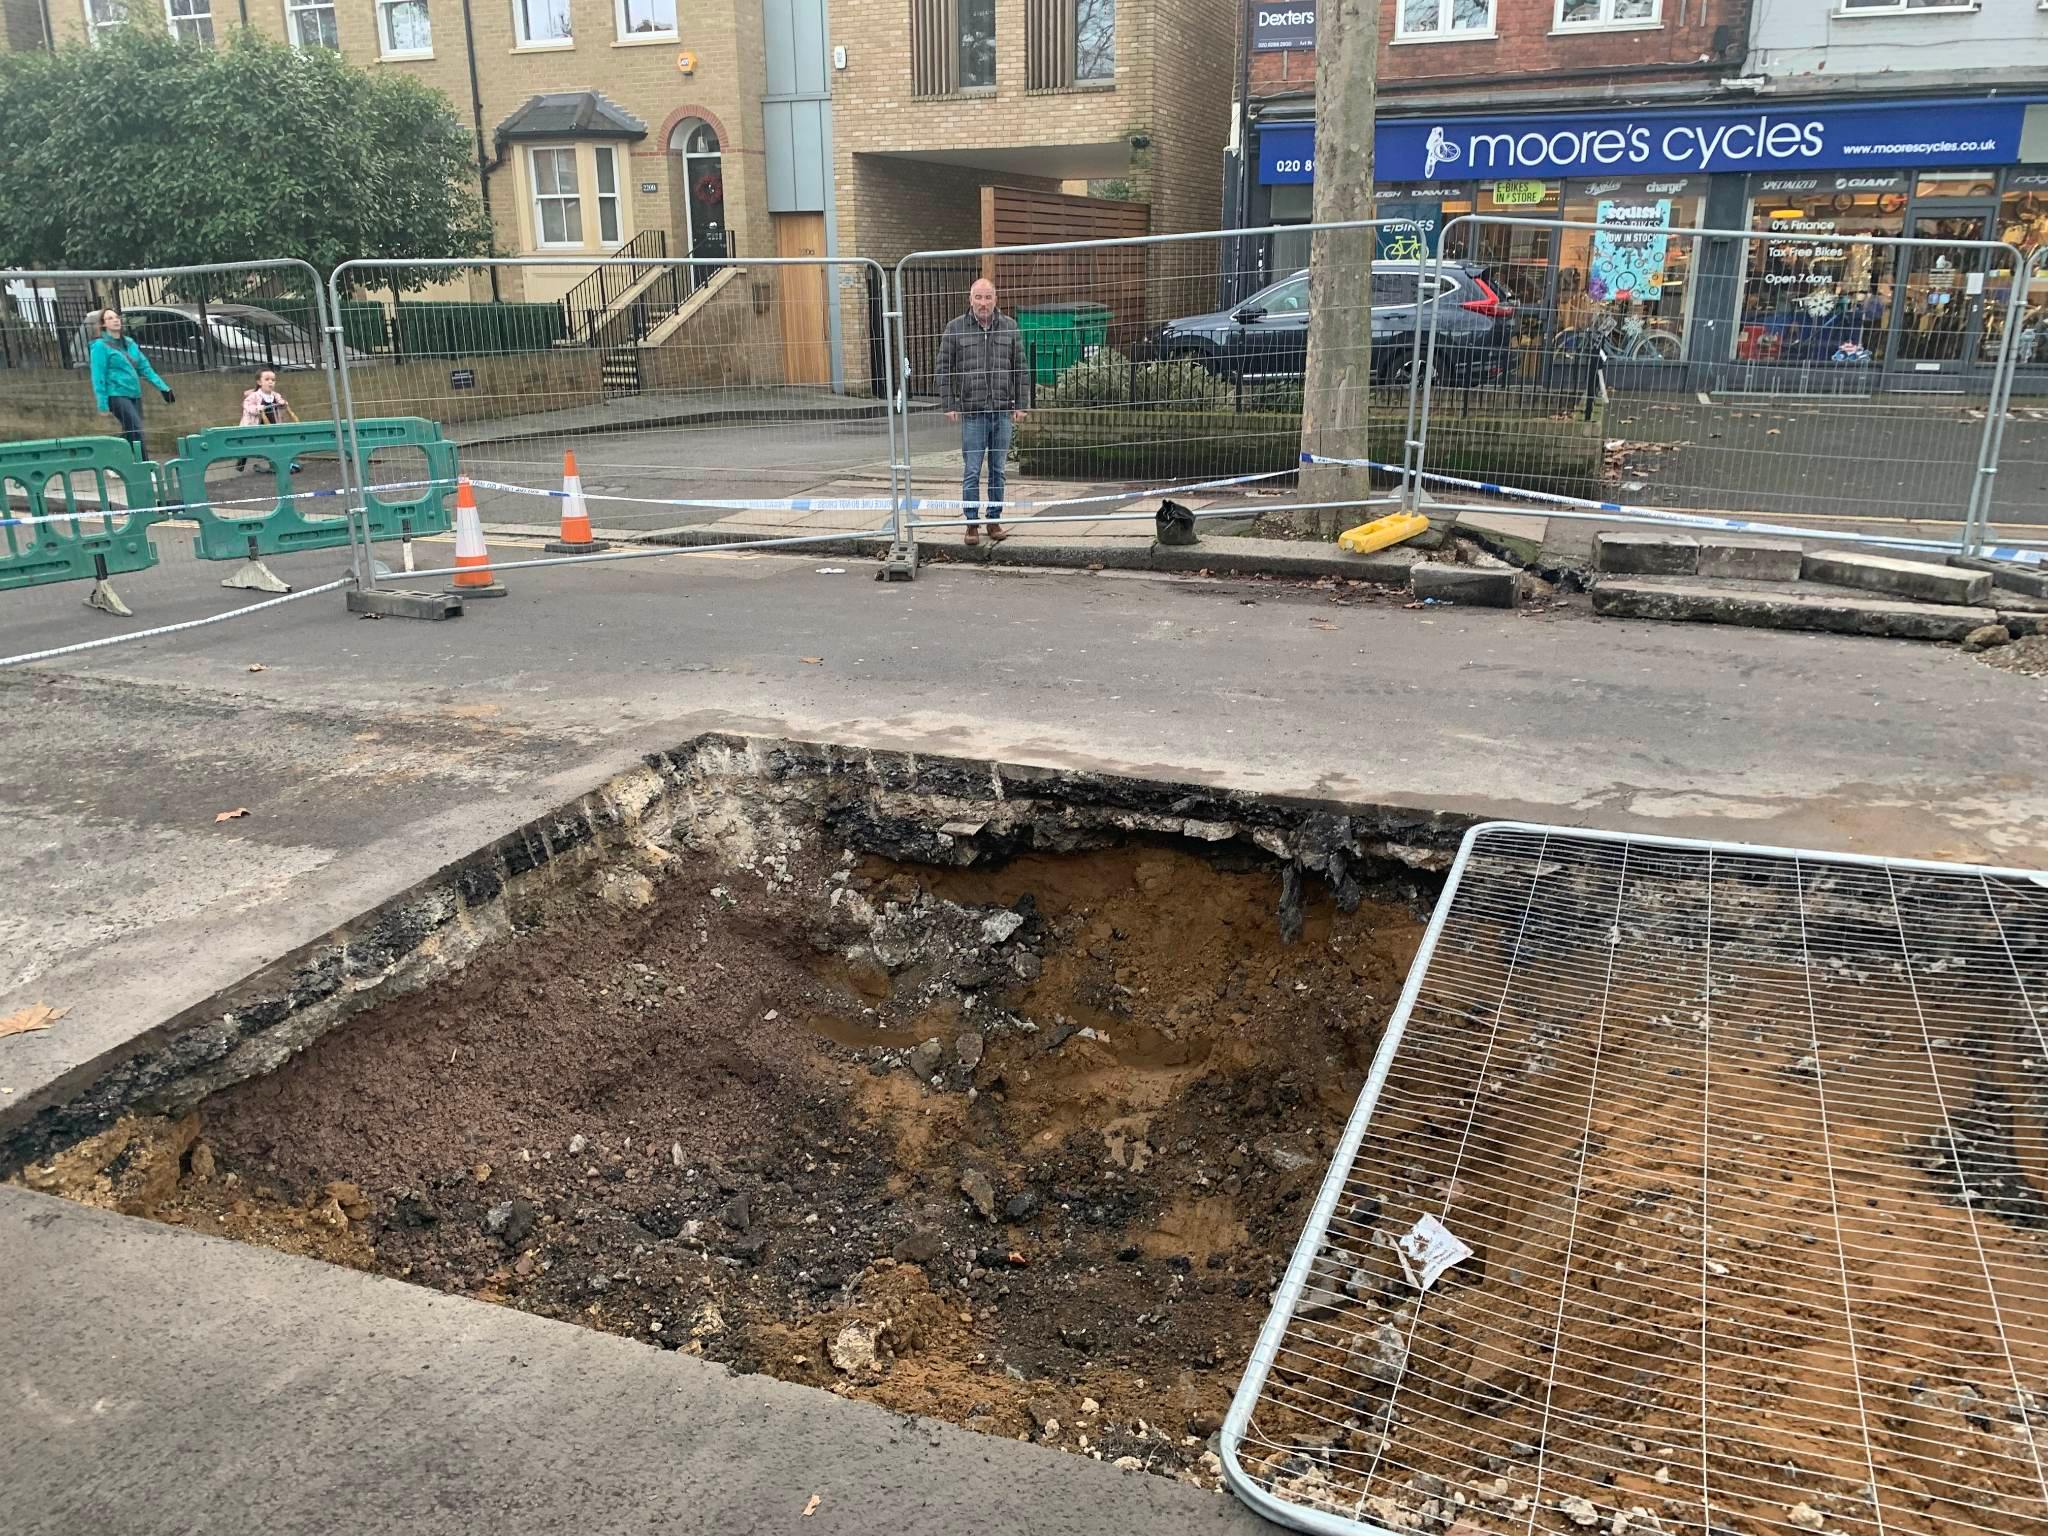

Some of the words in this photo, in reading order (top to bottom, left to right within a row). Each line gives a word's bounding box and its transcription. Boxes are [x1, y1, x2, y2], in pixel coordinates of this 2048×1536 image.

[1259, 10, 1315, 26] Dexters
[1468, 123, 1650, 167] moore's
[1662, 115, 1824, 169] cycles
[1843, 139, 1996, 154] www.moorescycles.co.uk
[1276, 160, 1300, 172] 020
[1304, 159, 1316, 171] 8
[1497, 182, 1529, 193] E-BIKES
[1760, 180, 1818, 190] SPECIALIZED
[1848, 177, 1899, 187] GIANT
[1411, 189, 1461, 197] DAWES
[1496, 192, 1505, 202] IN
[1512, 192, 1537, 203] STORE
[1772, 220, 1788, 230] 0%
[1791, 220, 1835, 230] Finance
[1623, 232, 1632, 242] IN
[1633, 232, 1658, 242] STOCK
[1769, 247, 1786, 257] Tax
[1789, 247, 1812, 257] Free
[1815, 246, 1843, 257] Bikes
[1765, 273, 1796, 286] Open
[1799, 273, 1805, 283] 7
[1806, 273, 1833, 286] days
